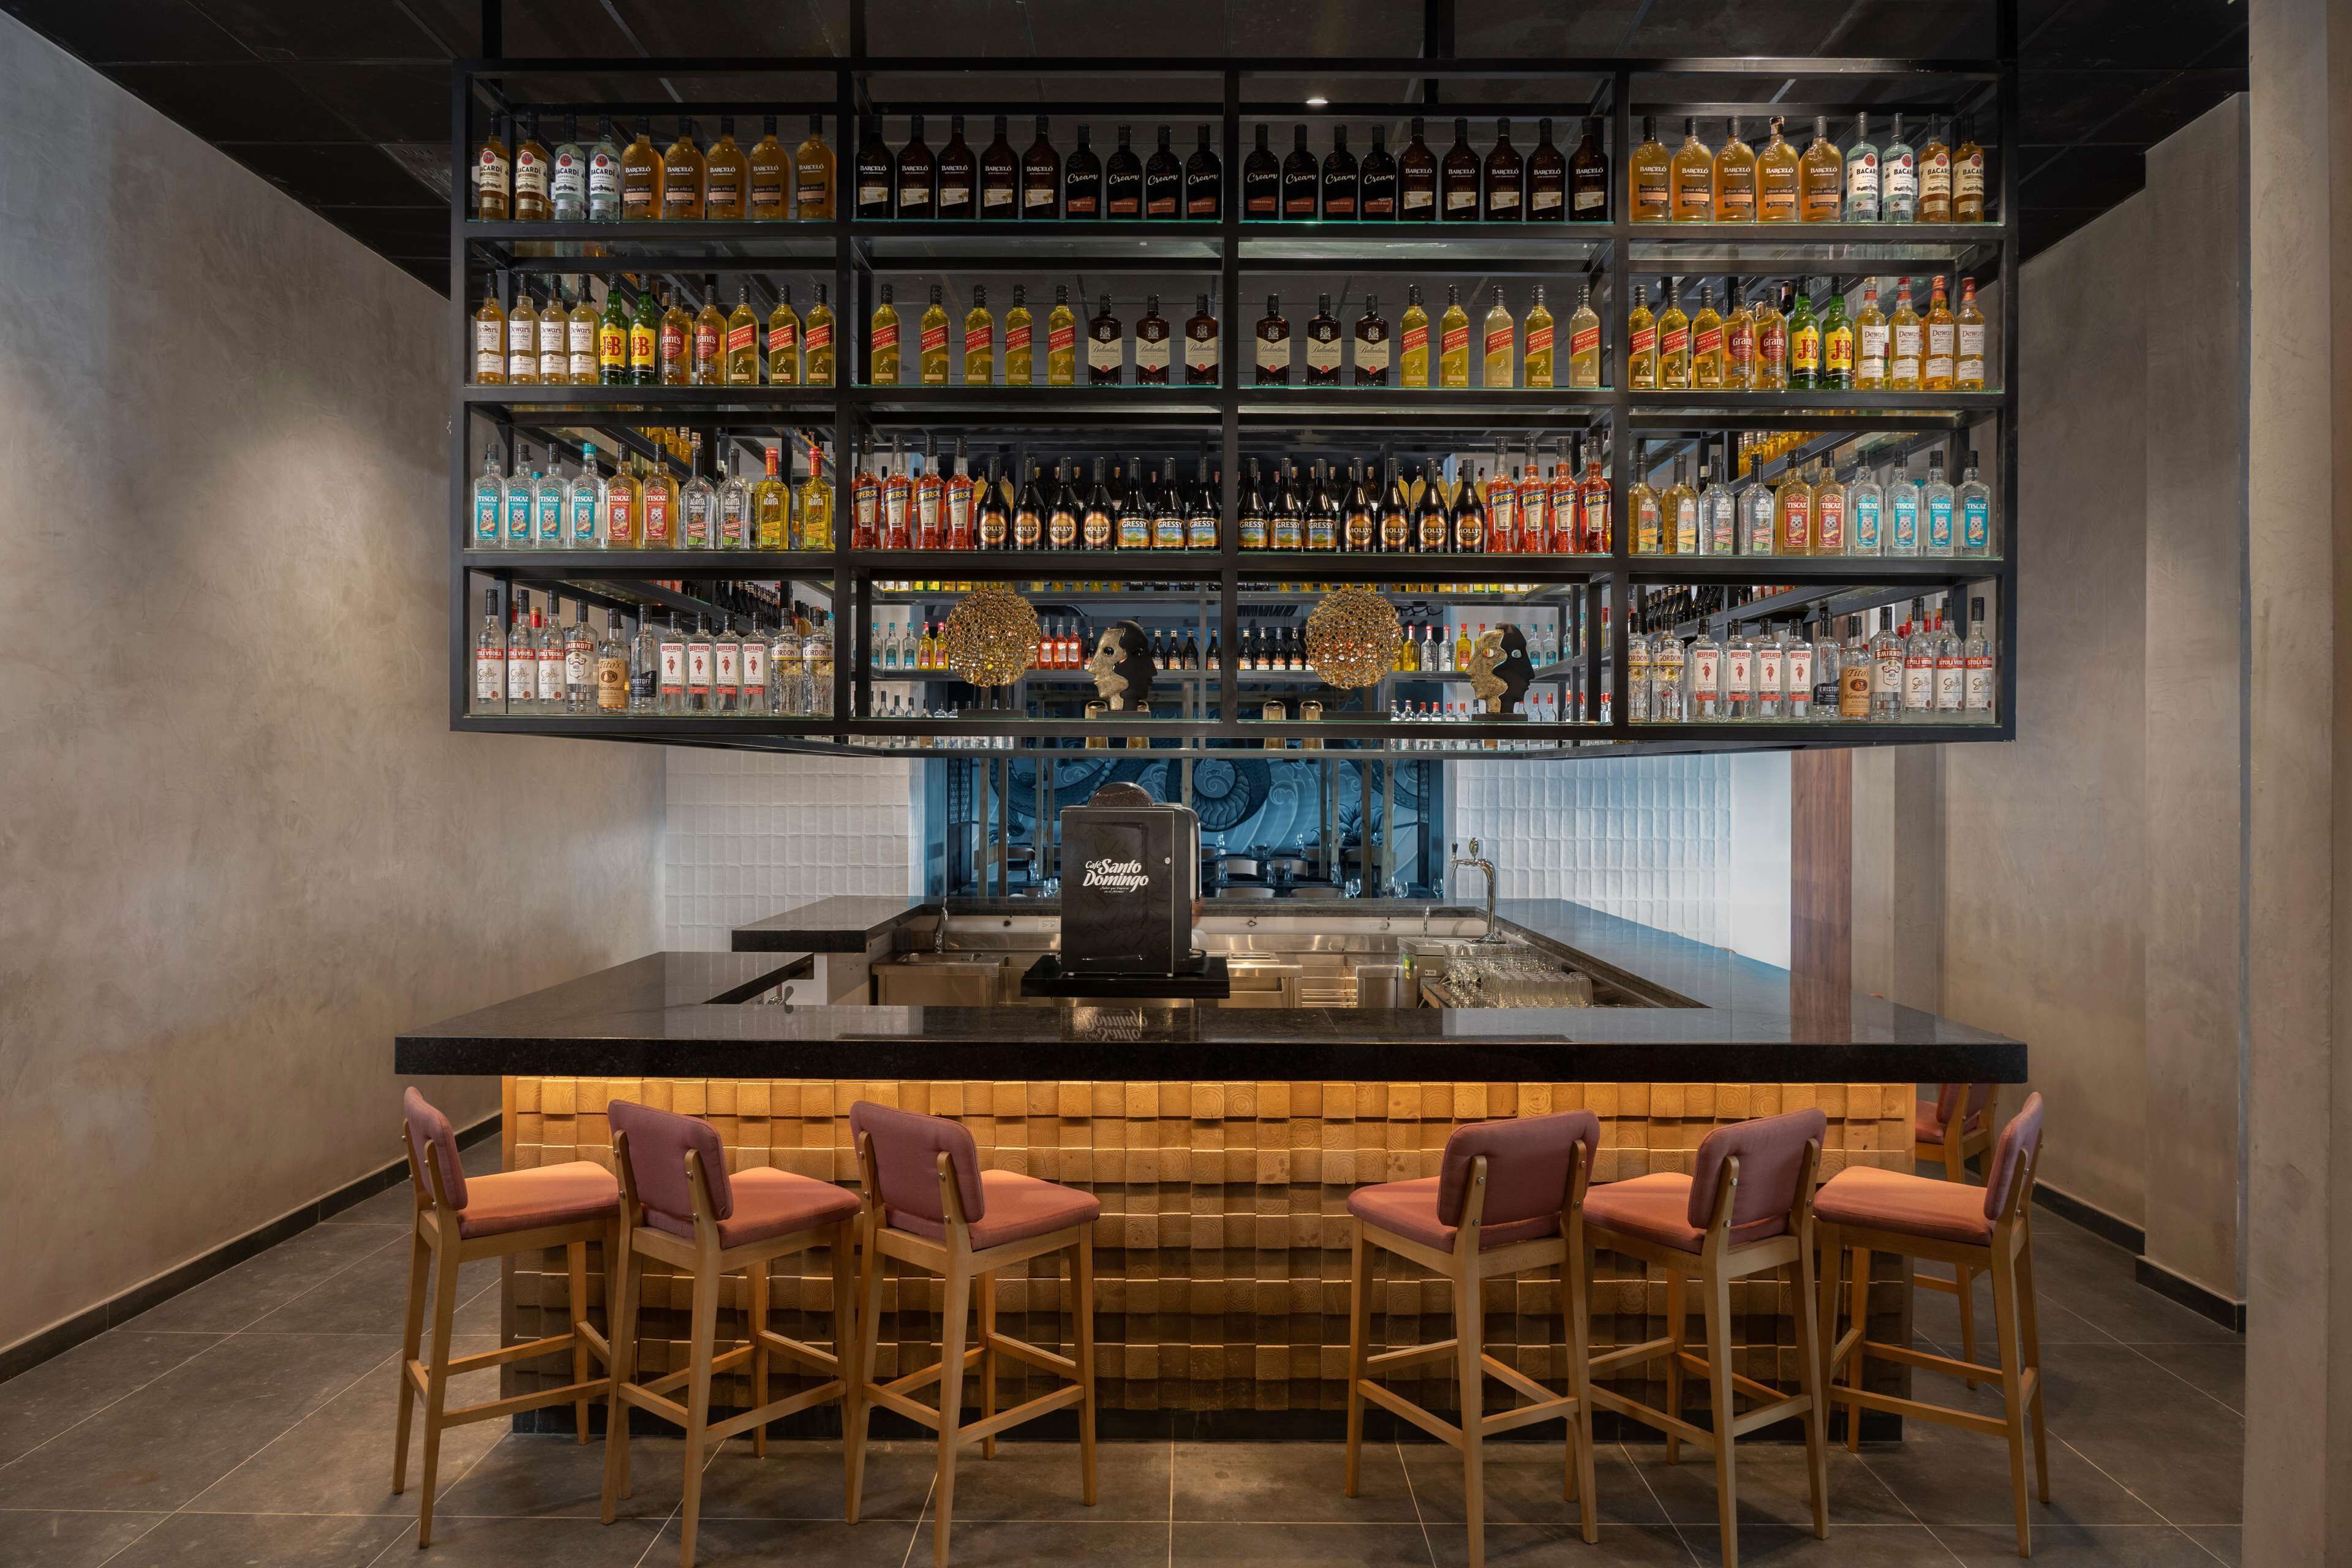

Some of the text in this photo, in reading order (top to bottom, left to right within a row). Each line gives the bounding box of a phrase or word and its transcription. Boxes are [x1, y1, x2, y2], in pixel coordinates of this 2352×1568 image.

[798, 164, 824, 172] BARCELÓ
[1067, 172, 1098, 184] Cream
[1108, 173, 1140, 185] Cream
[1147, 173, 1178, 186] Cream
[1188, 173, 1218, 186] Cream
[1246, 172, 1278, 183] Cream
[1285, 172, 1317, 184] Cream
[1325, 172, 1356, 184] Cream
[1363, 172, 1395, 184] Cream
[662, 336, 681, 344] rant's
[738, 331, 752, 339] LABEL
[816, 331, 830, 339] LABEL
[1413, 333, 1427, 341] LABEL
[1499, 333, 1512, 342] LABEL
[1585, 333, 1598, 342] LABEL
[601, 336, 622, 356] J&B
[630, 336, 650, 357] J&B
[1798, 339, 1817, 360] J&B
[1831, 339, 1852, 360] J&B
[854, 489, 878, 500] APEROL
[885, 489, 908, 500] APEROL
[918, 489, 941, 501] APEROL
[948, 490, 971, 501] APEROL
[1491, 492, 1515, 504] APEROL
[1523, 493, 1546, 505] APEROL
[1552, 492, 1576, 505] APEROL
[1585, 493, 1608, 505] APEROL
[1085, 858, 1142, 875] Café Santo
[1082, 870, 1149, 892] Domingo
